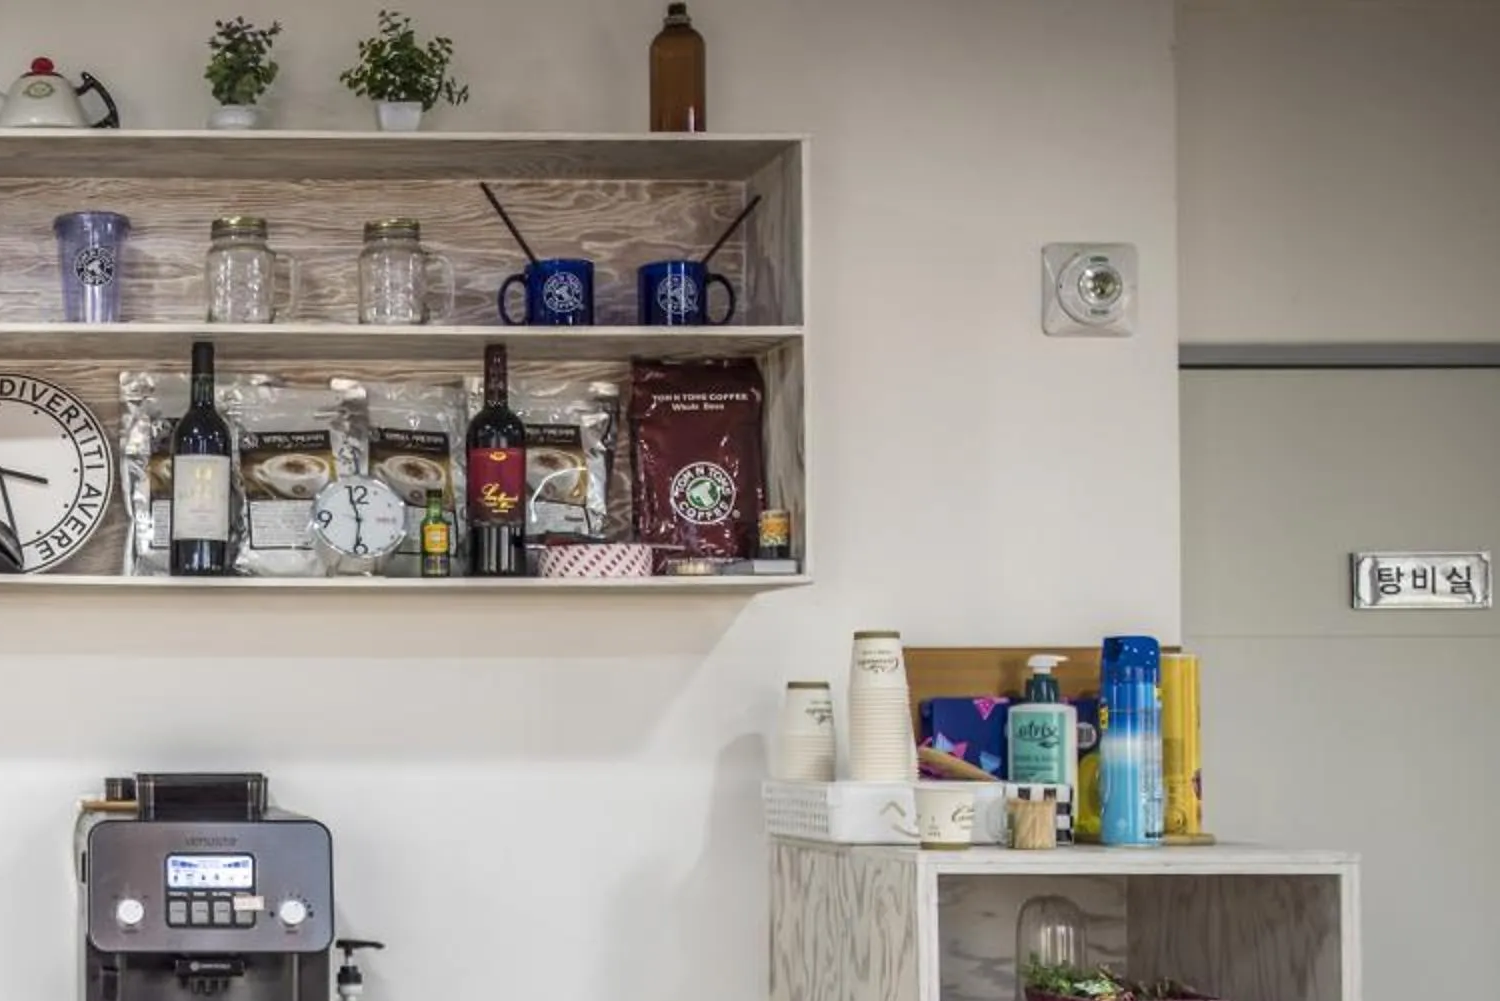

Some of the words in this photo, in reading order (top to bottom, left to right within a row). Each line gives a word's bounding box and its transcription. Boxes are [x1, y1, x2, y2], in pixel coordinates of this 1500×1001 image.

[709, 392, 750, 401] COFFEE
[0, 378, 105, 470] DIVERTITI
[344, 485, 369, 506] 12
[317, 509, 332, 529] 9
[678, 501, 729, 521] COFFEE
[38, 483, 103, 561] AVERE
[1377, 565, 1472, 595] 탕비실
